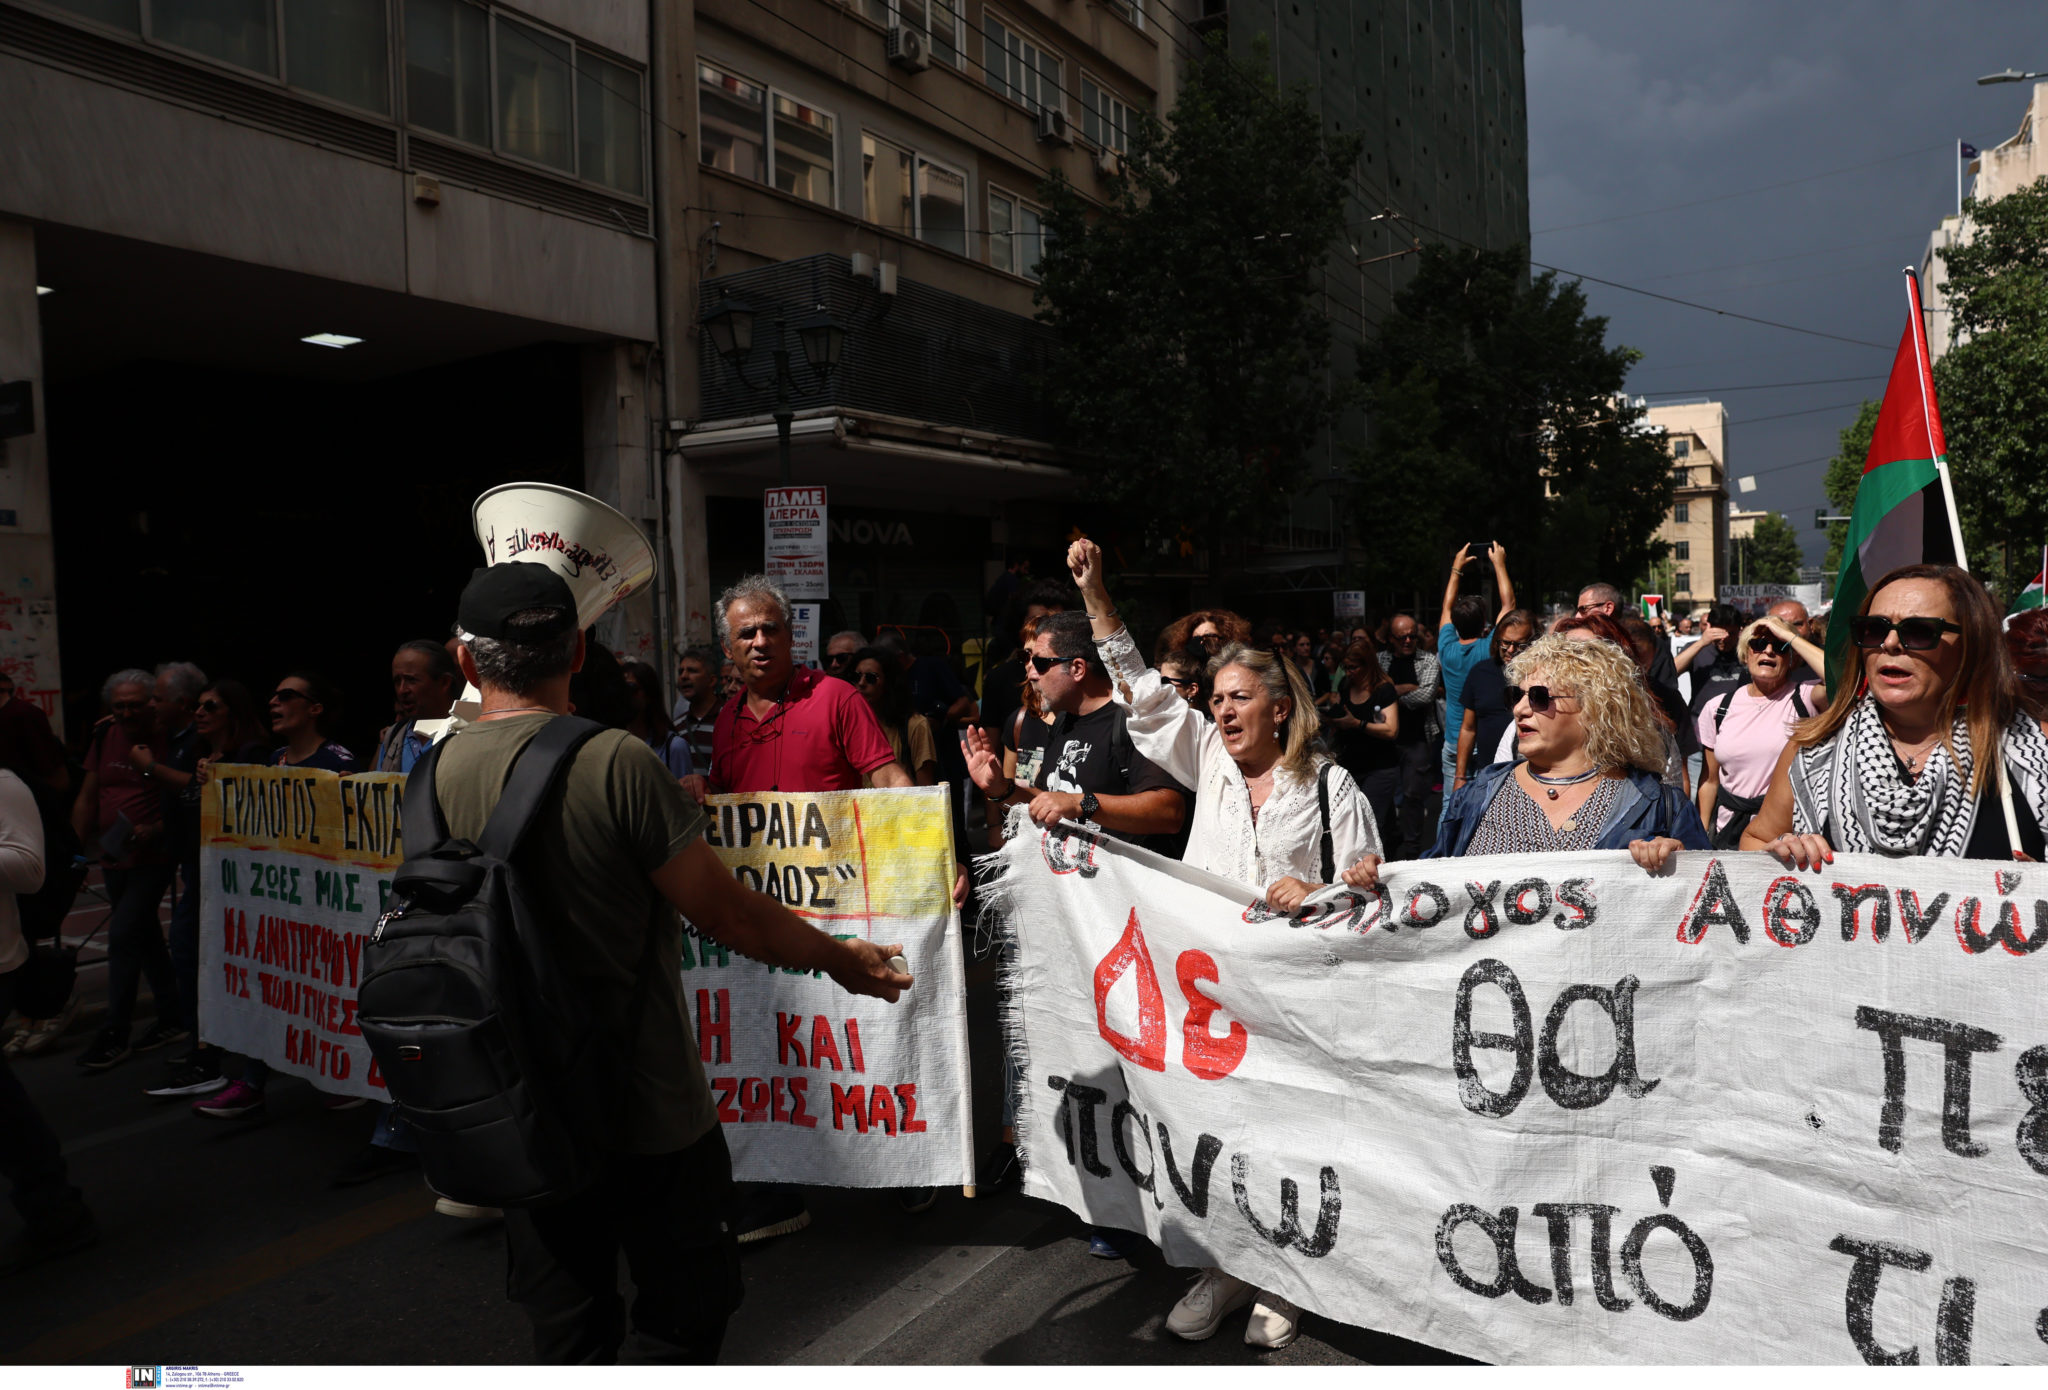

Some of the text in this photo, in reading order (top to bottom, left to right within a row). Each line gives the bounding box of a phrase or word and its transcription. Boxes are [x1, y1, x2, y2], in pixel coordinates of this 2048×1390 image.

[767, 491, 823, 507] ΠΑΜΕ
[769, 508, 819, 520] ΑΠΕΡΓΙΑ
[222, 776, 402, 858] ΣΥΛΛΟΓΟΣ ΕΚΠΑ
[703, 802, 831, 848] ΕΙΡΑΙΑ
[222, 859, 239, 894] ΟΙ
[250, 862, 302, 905] ΖΩΕΣ
[315, 869, 362, 912] ΜΑΣ
[1676, 858, 2048, 956] Αθηνώ
[224, 907, 368, 988] ΝΑ ΑΝΑΤΡΕΨΟΥ
[224, 963, 361, 1036] ΤΙΣ ΠΟΛΙΤΙΚΕΣ
[286, 1024, 316, 1068] ΚΑΙ
[319, 1040, 351, 1080] ΤΟ
[776, 1011, 865, 1074] ΚΑΙ
[1453, 958, 1661, 1119] θα
[711, 1077, 927, 1137] ΖΩΕΣ ΜΑΣ
[1434, 1164, 1714, 1322] από
[1829, 1233, 2048, 1365] τι
